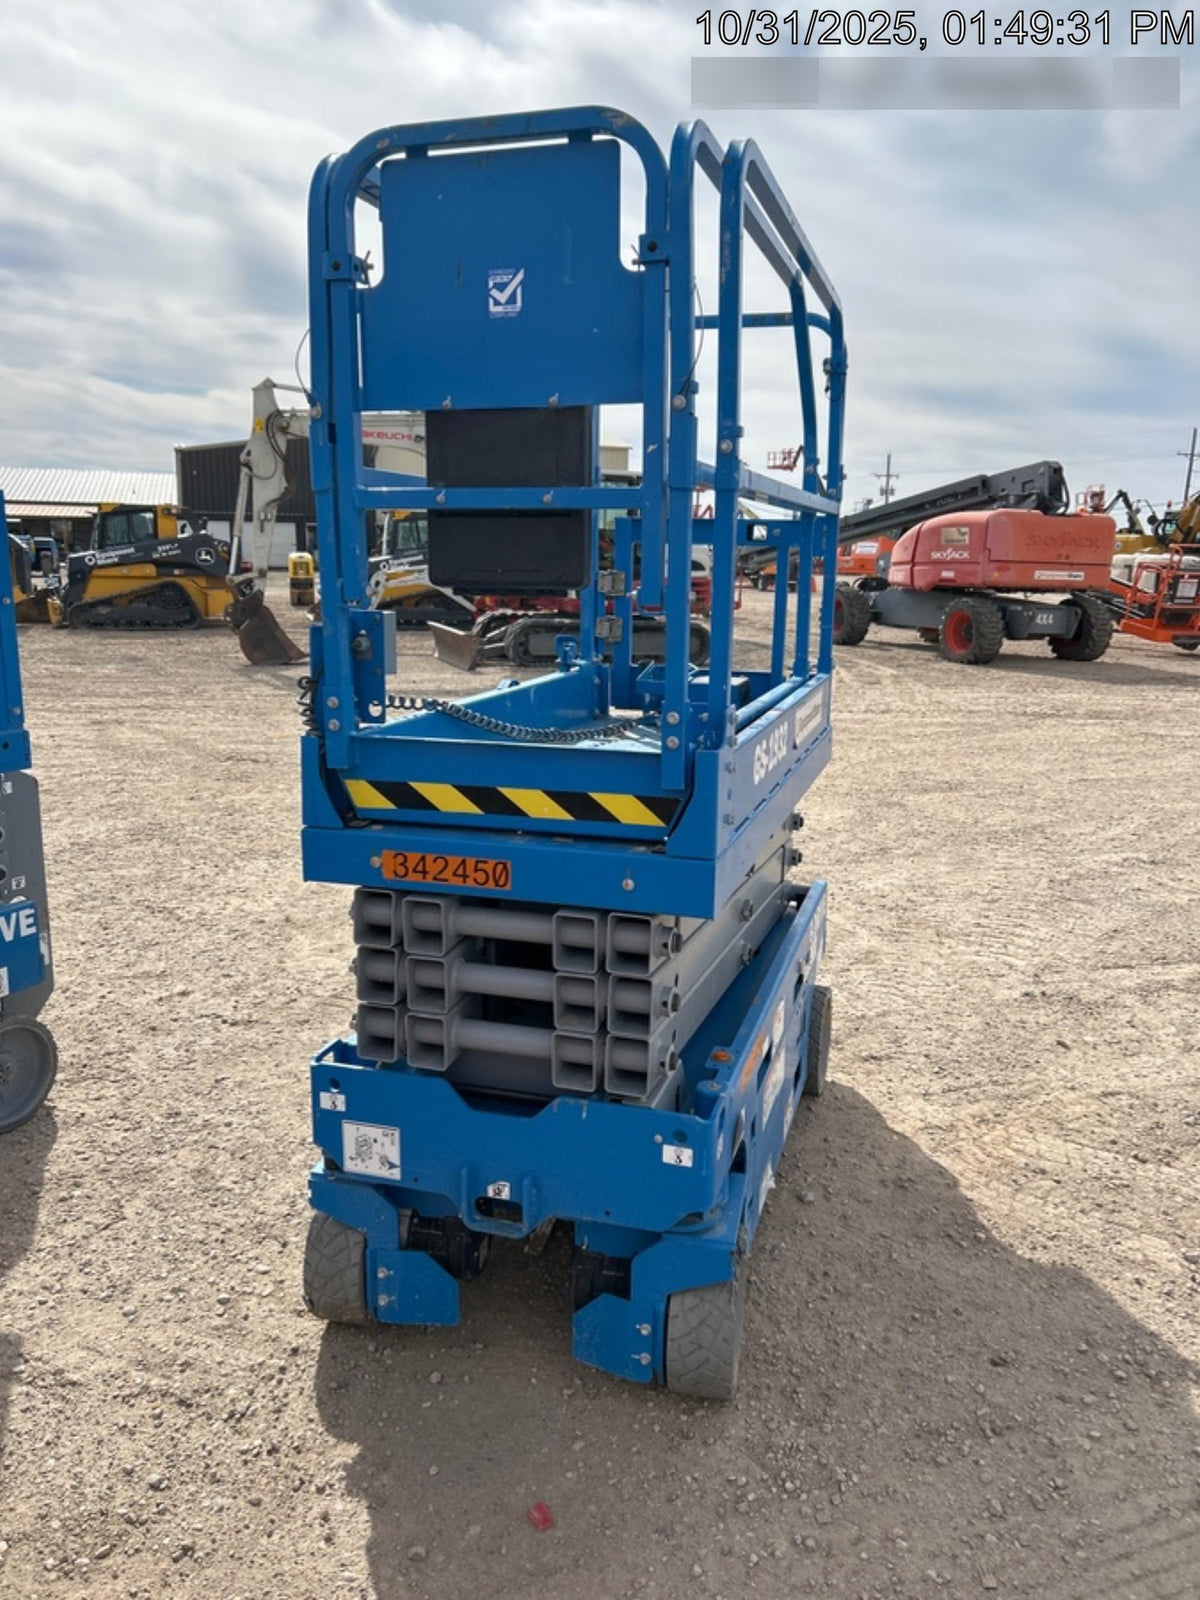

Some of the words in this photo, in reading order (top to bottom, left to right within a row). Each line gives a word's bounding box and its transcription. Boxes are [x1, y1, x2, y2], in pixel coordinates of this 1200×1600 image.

[361, 429, 413, 441] AKEUCHI
[930, 547, 970, 561] SKYJACK
[391, 852, 510, 888] 342450
[0, 907, 37, 943] VE
